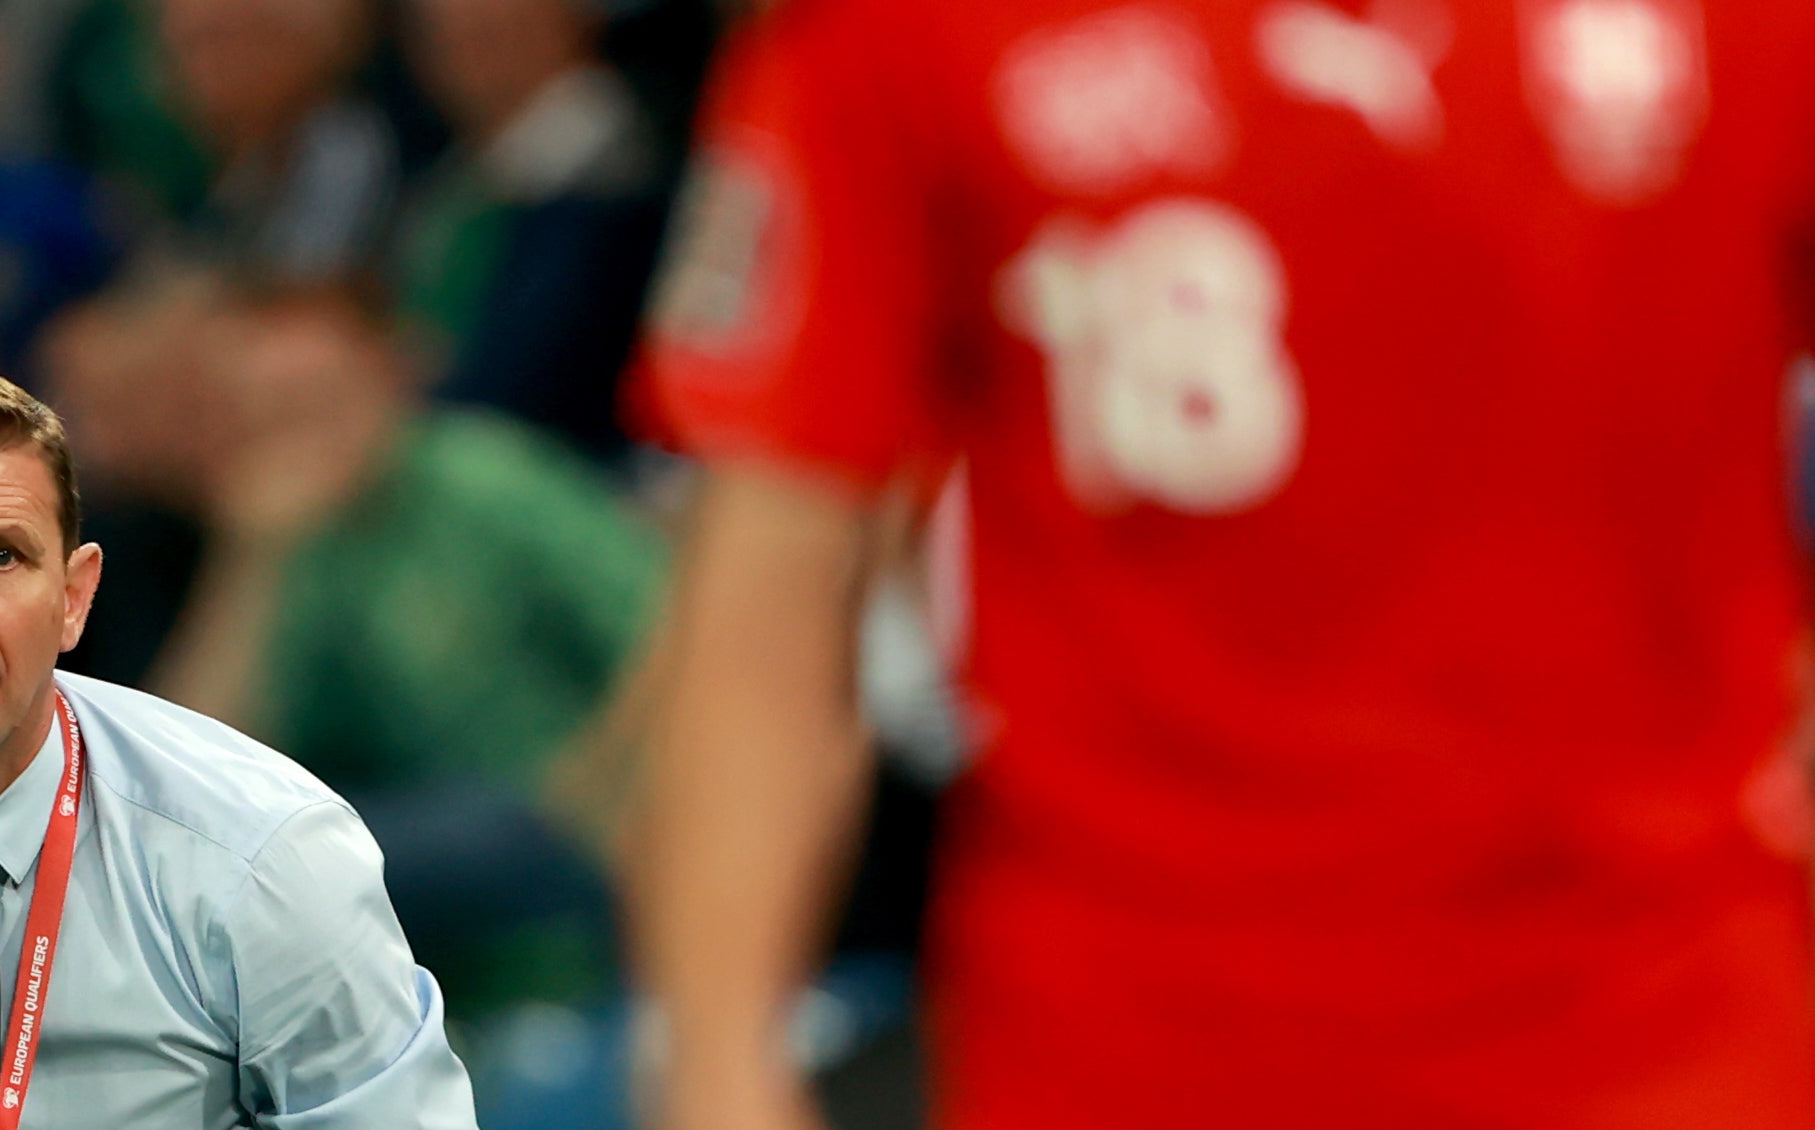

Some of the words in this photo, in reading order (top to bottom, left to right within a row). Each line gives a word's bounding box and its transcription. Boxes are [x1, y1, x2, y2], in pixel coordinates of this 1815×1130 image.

[999, 198, 1304, 513] 18
[67, 724, 80, 793] EUROPEAN
[10, 1013, 35, 1085] EUROPEAN
[24, 935, 49, 1012] QUALIFIERS
